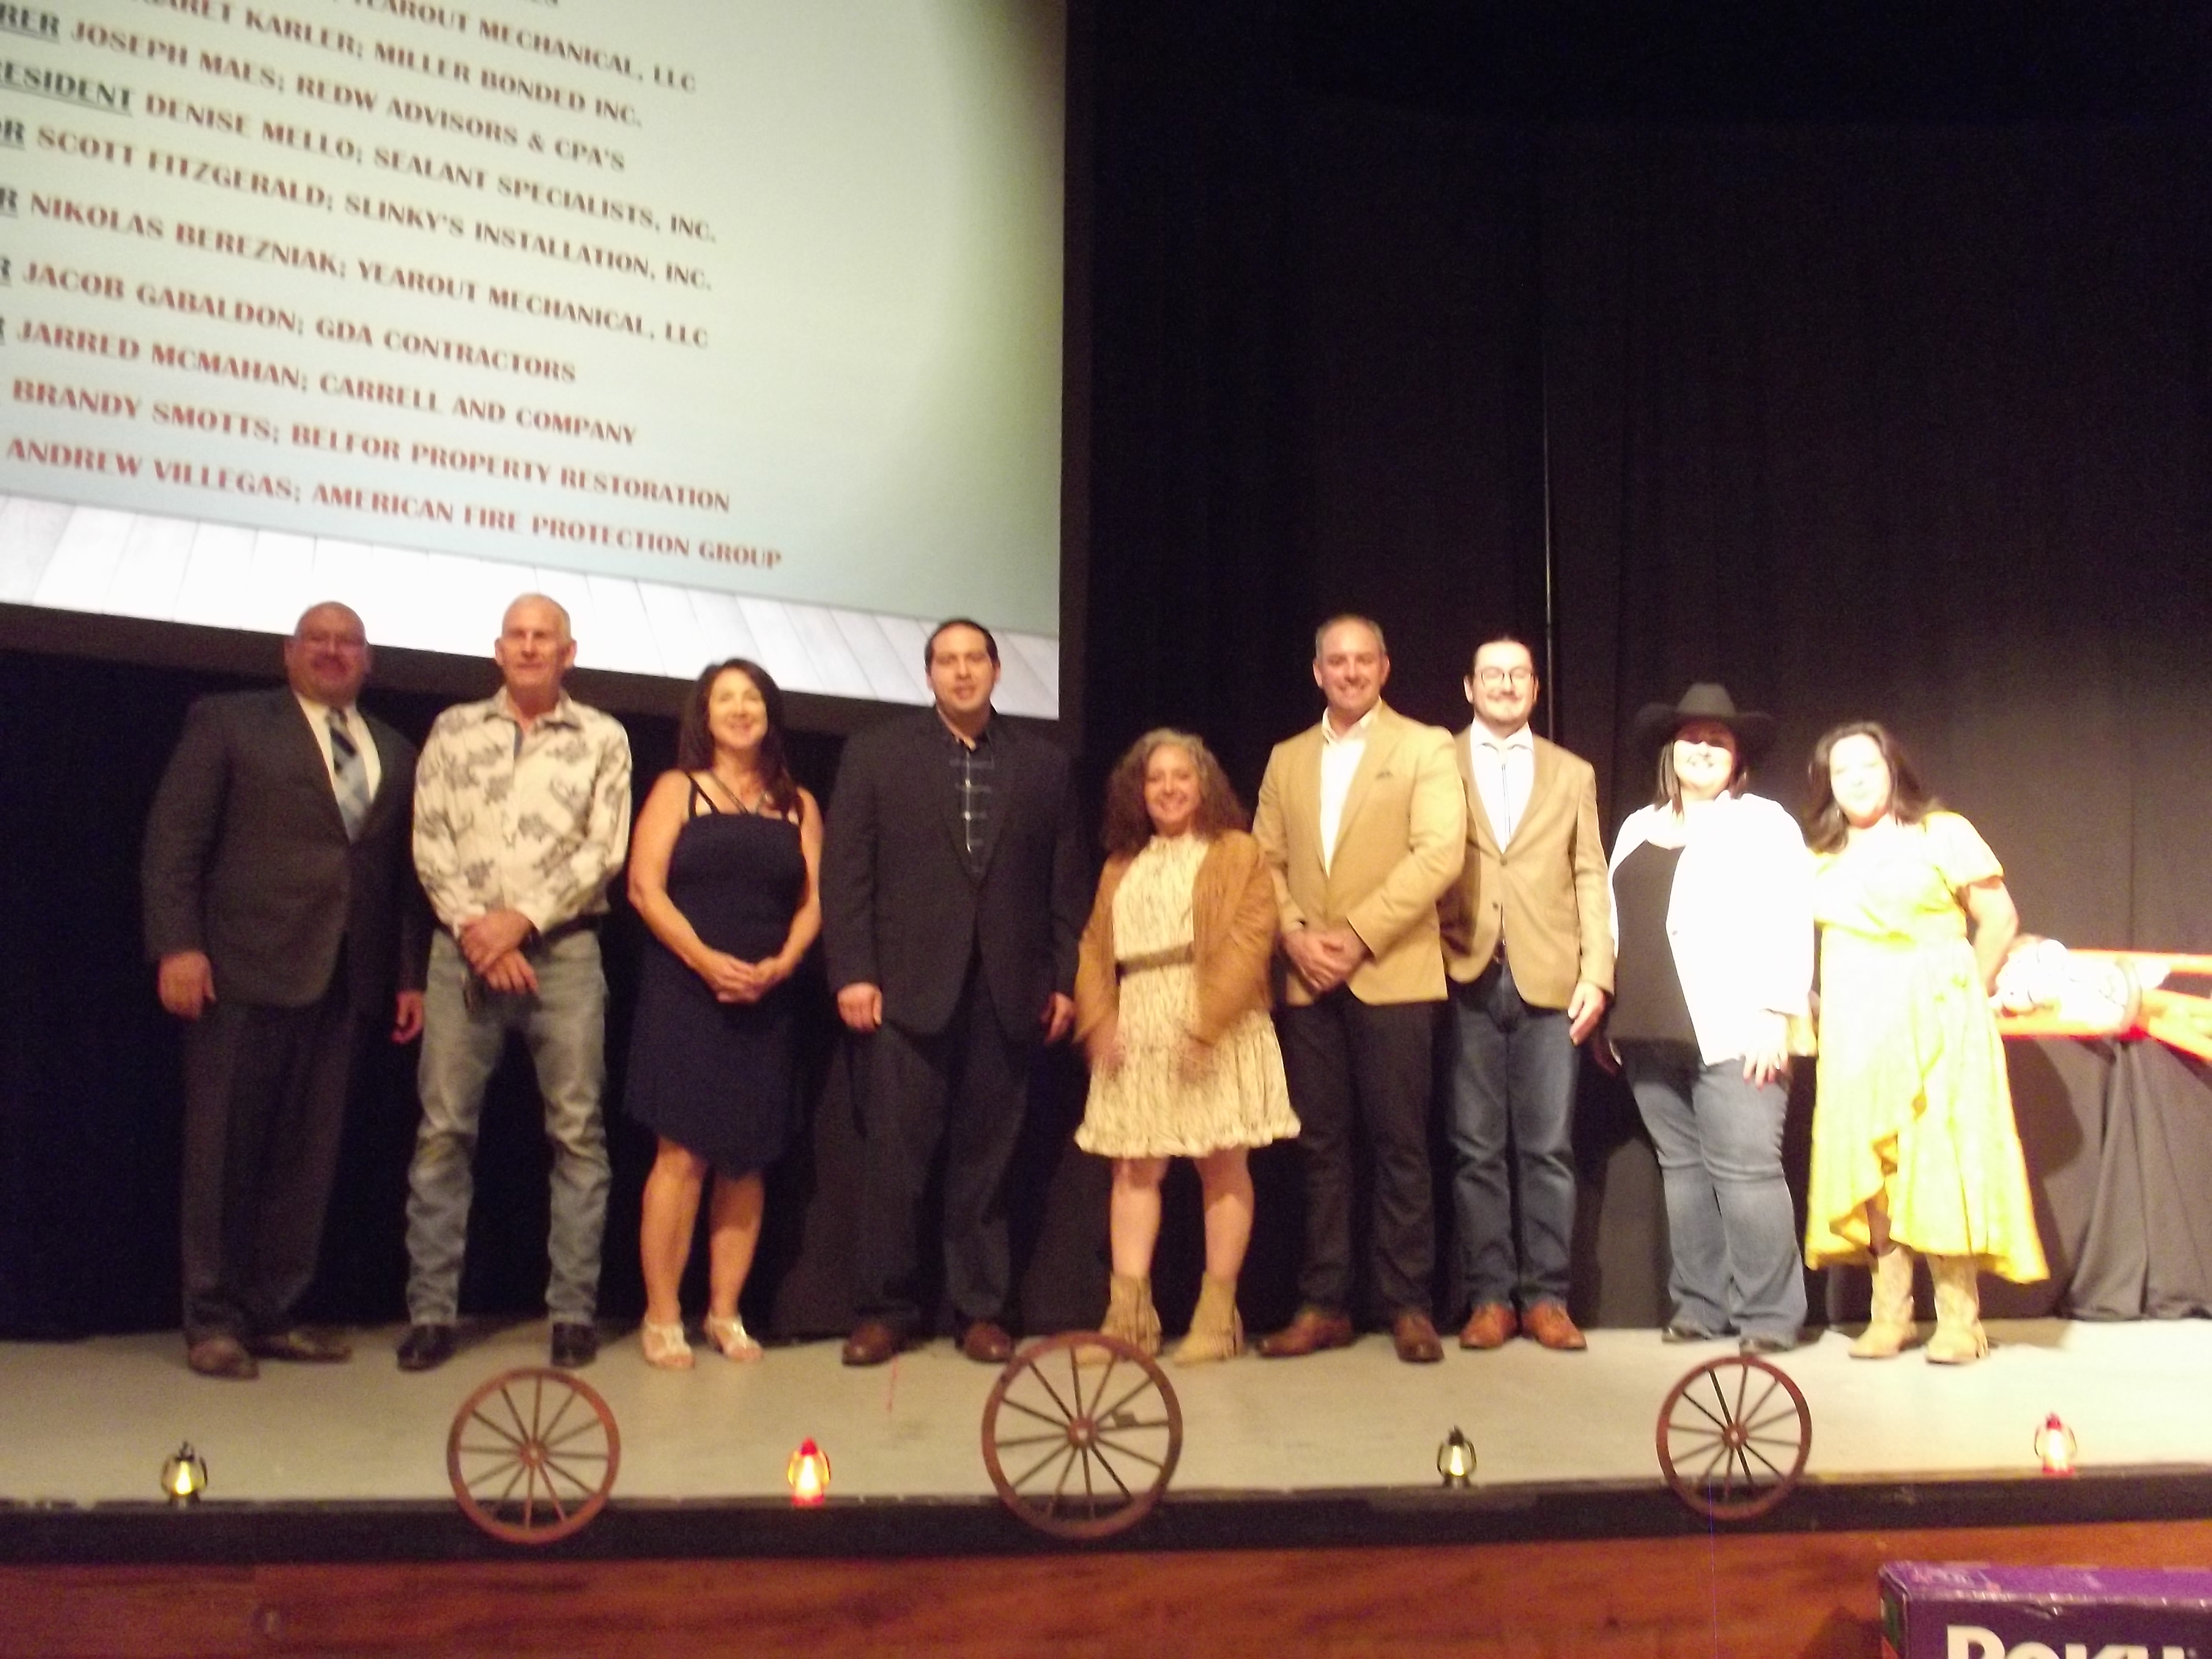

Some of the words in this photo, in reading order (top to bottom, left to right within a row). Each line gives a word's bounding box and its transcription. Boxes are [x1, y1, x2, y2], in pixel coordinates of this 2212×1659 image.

[71, 21, 187, 67] JOSEPH
[297, 75, 377, 112] REDW
[387, 98, 517, 145] ADVISORS
[528, 133, 544, 153] &
[555, 139, 624, 171] CPA'S
[246, 8, 363, 59] KARLER;
[375, 42, 469, 84] MILLER
[481, 69, 585, 111] BONDED
[596, 99, 641, 126] INC.
[480, 19, 642, 81] MECHANICAL,
[655, 66, 694, 91] LLC
[0, 61, 134, 108] ESIDENT
[146, 93, 249, 136] DENISE
[263, 121, 362, 164] MELLO;
[375, 148, 486, 189] SEALANT
[498, 176, 659, 232] SPECIALISTS,
[671, 215, 715, 241] INC.
[37, 127, 135, 166] SCOTT
[149, 150, 332, 212] FITZGERALD;
[346, 195, 464, 236] SLINKY'S
[476, 222, 655, 280] INSTALLATION,
[666, 263, 710, 289] INC.
[24, 262, 124, 300] JACOB
[136, 284, 303, 335] GABALDON;
[316, 318, 372, 346] GDA
[384, 331, 575, 382] CONTRACTORS
[31, 193, 163, 238] NIKOLAS
[175, 223, 345, 279] BEREZNIAK;
[359, 260, 477, 302] YEAROUT
[490, 287, 654, 339] MECHANICAL,
[666, 323, 707, 347] LLC
[13, 379, 141, 418] BRANDY
[153, 403, 279, 444] SMOTTS;
[292, 424, 399, 460] BELFOR
[412, 444, 550, 483] PROPERTY
[561, 468, 729, 512] RESTORATION
[17, 320, 140, 360] JARRED
[152, 343, 307, 392] MCMAHAN;
[320, 375, 440, 412] CARRELL
[453, 397, 505, 422] AND
[516, 409, 635, 445] COMPANY
[7, 438, 142, 477] ANDREW
[154, 460, 300, 503] VILLEGAS;
[313, 484, 453, 523] AMERICAN
[465, 506, 517, 531] FIRE
[532, 516, 689, 557] PROTECTION
[698, 542, 781, 569] GROUP
